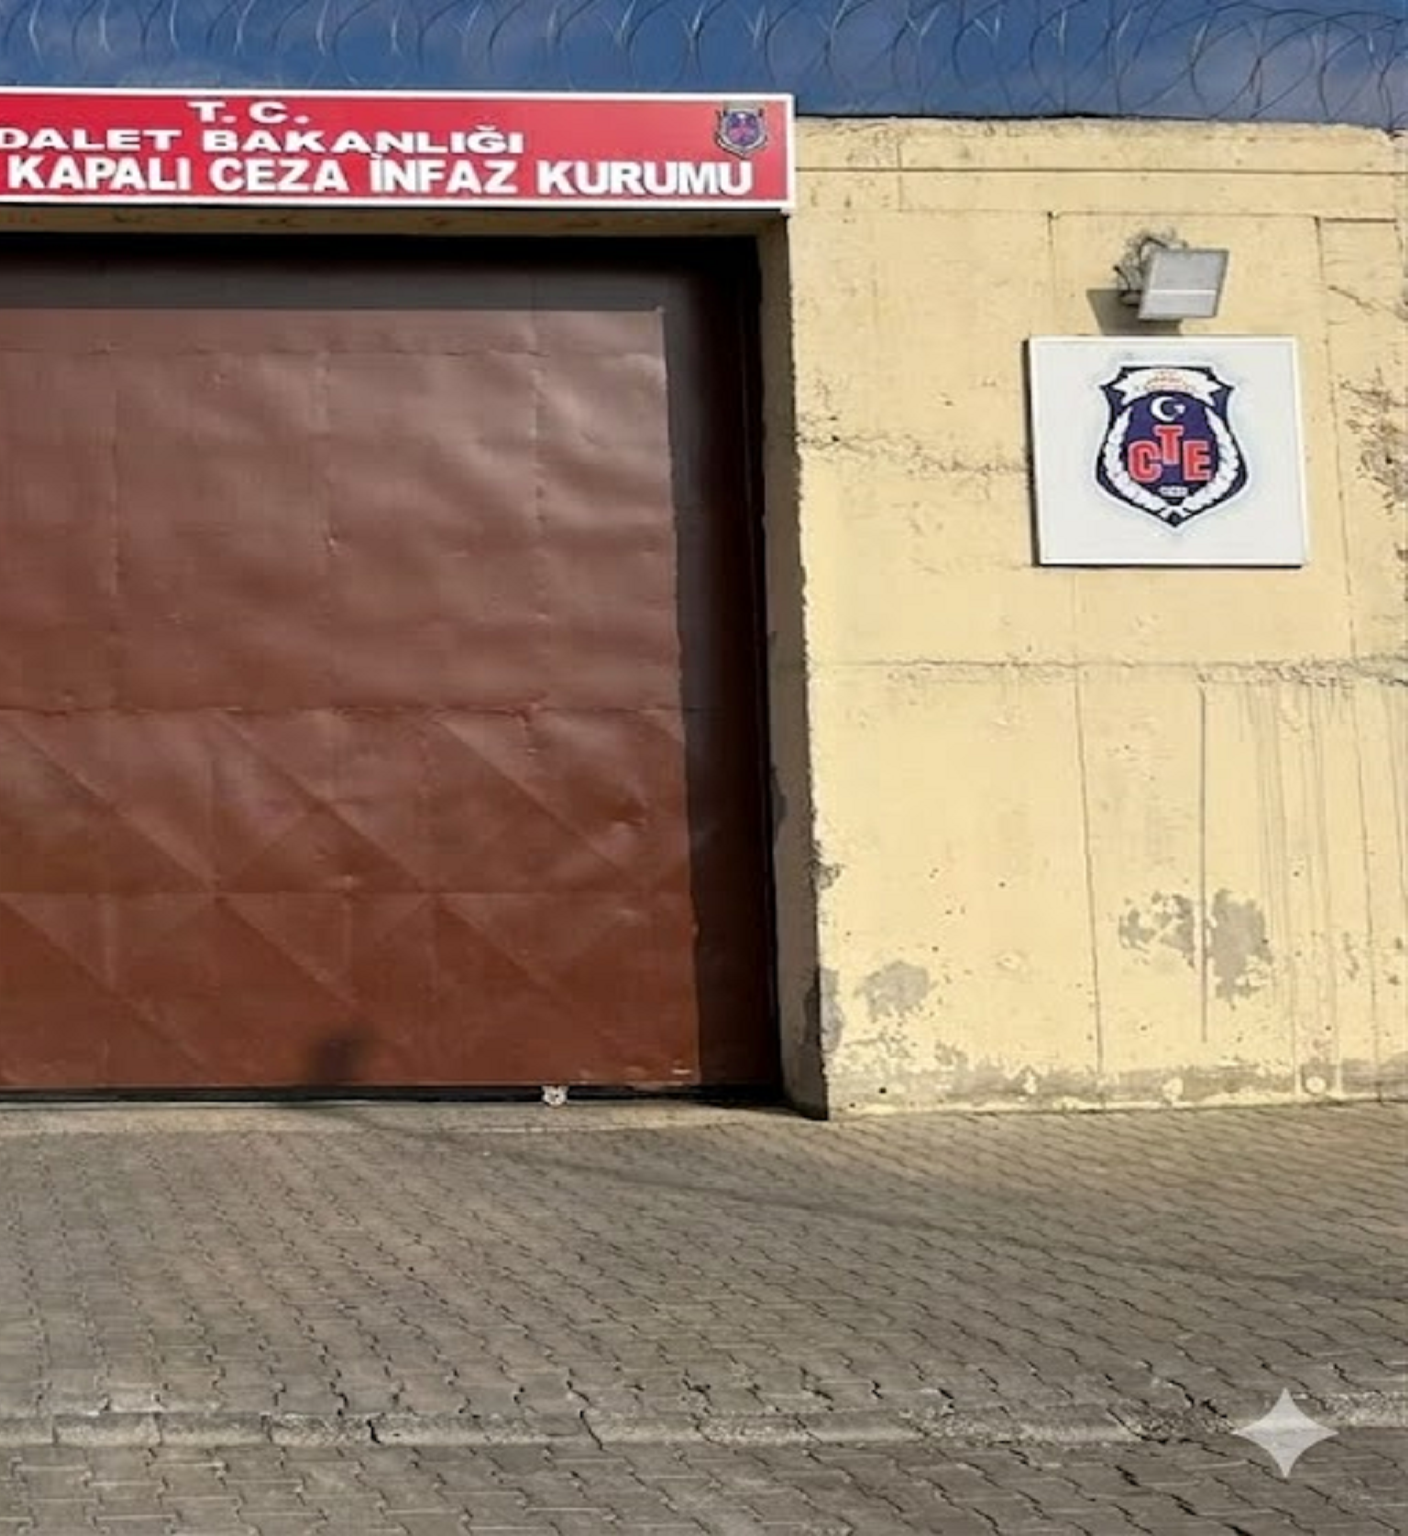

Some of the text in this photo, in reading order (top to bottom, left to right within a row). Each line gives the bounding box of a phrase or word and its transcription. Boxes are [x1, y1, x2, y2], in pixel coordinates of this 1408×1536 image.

[187, 101, 310, 124] T. C.
[202, 126, 525, 154] BAKANLIĞI
[6, 154, 191, 191] KAPALI
[209, 158, 349, 193] CEZA
[369, 151, 518, 194] İNFAZ
[537, 161, 753, 195] KURUMU
[1127, 424, 1214, 483] CTE
